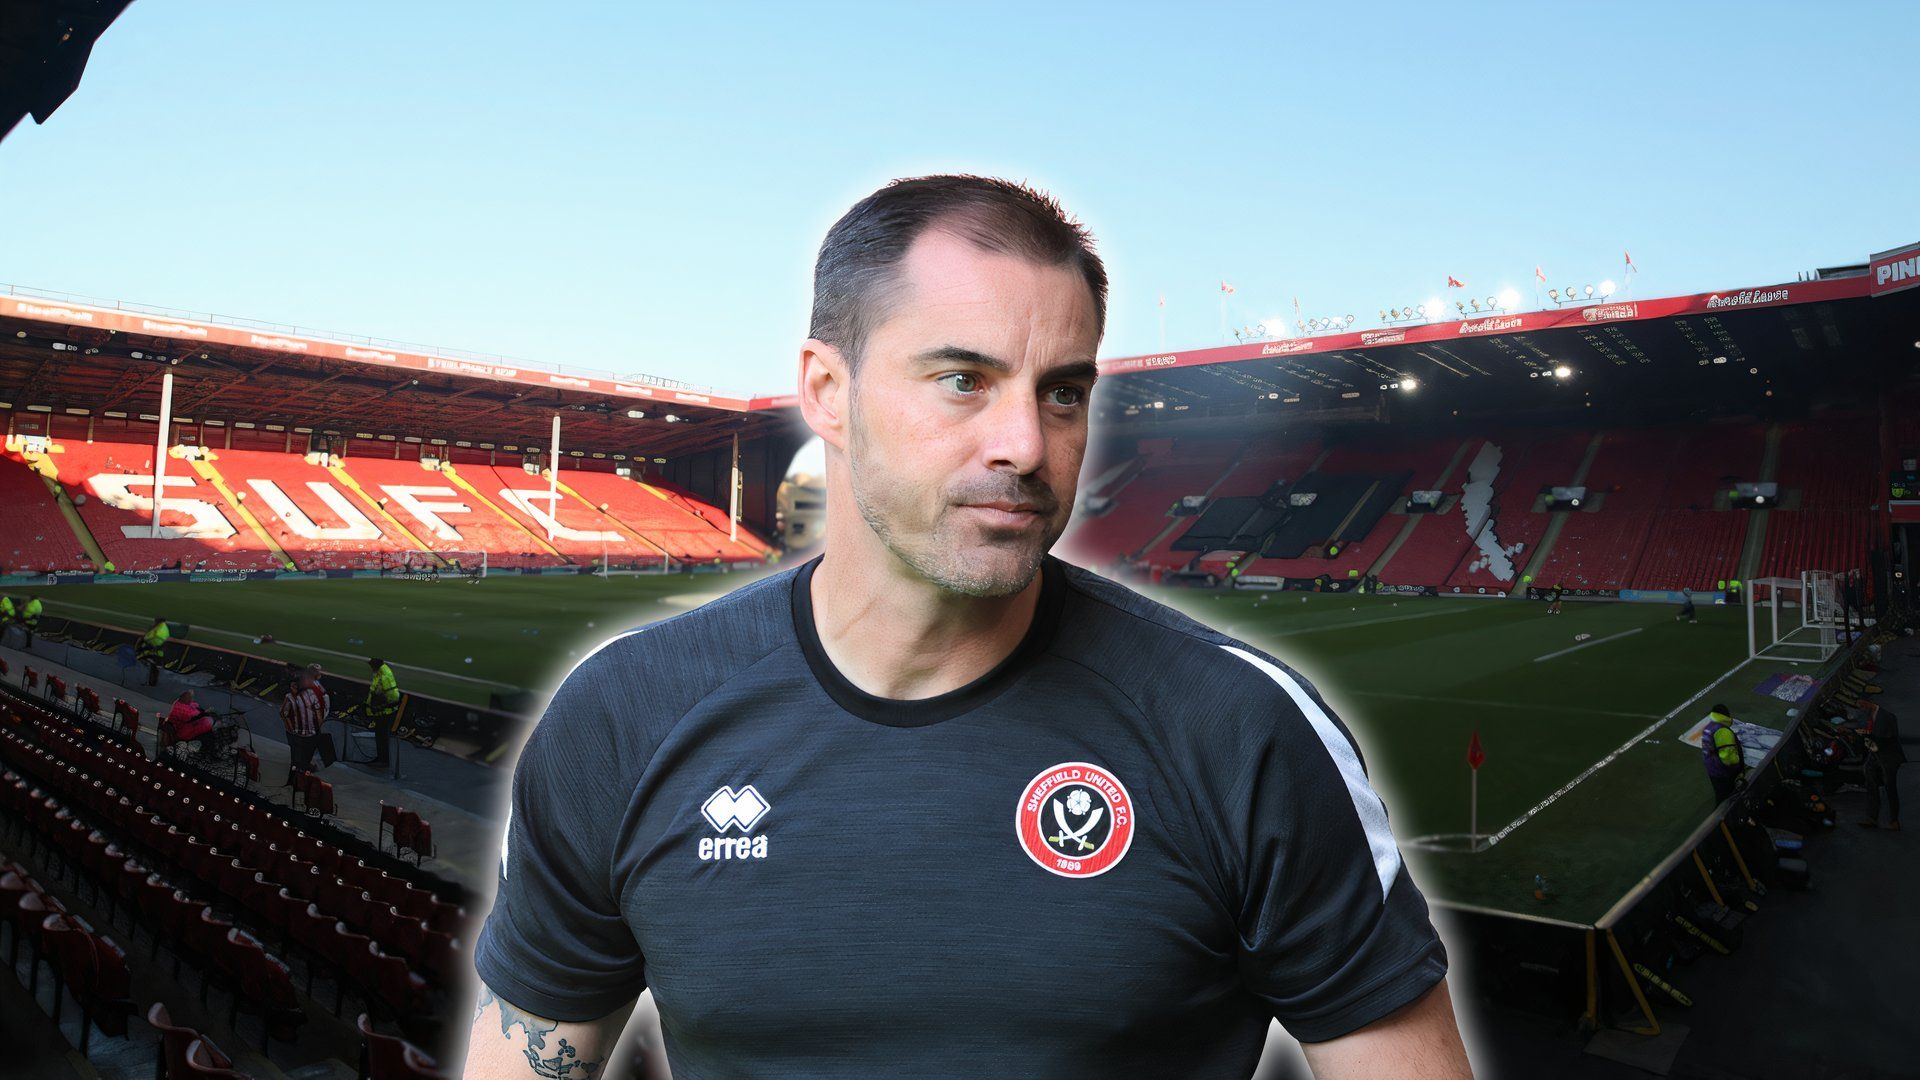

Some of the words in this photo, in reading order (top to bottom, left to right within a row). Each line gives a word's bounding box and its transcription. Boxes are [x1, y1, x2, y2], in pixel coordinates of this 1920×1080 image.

[1877, 255, 1920, 286] PIN
[88, 472, 625, 540] SUFC
[1027, 769, 1081, 812] SHEFFIELD
[1084, 771, 1122, 803] UNITED
